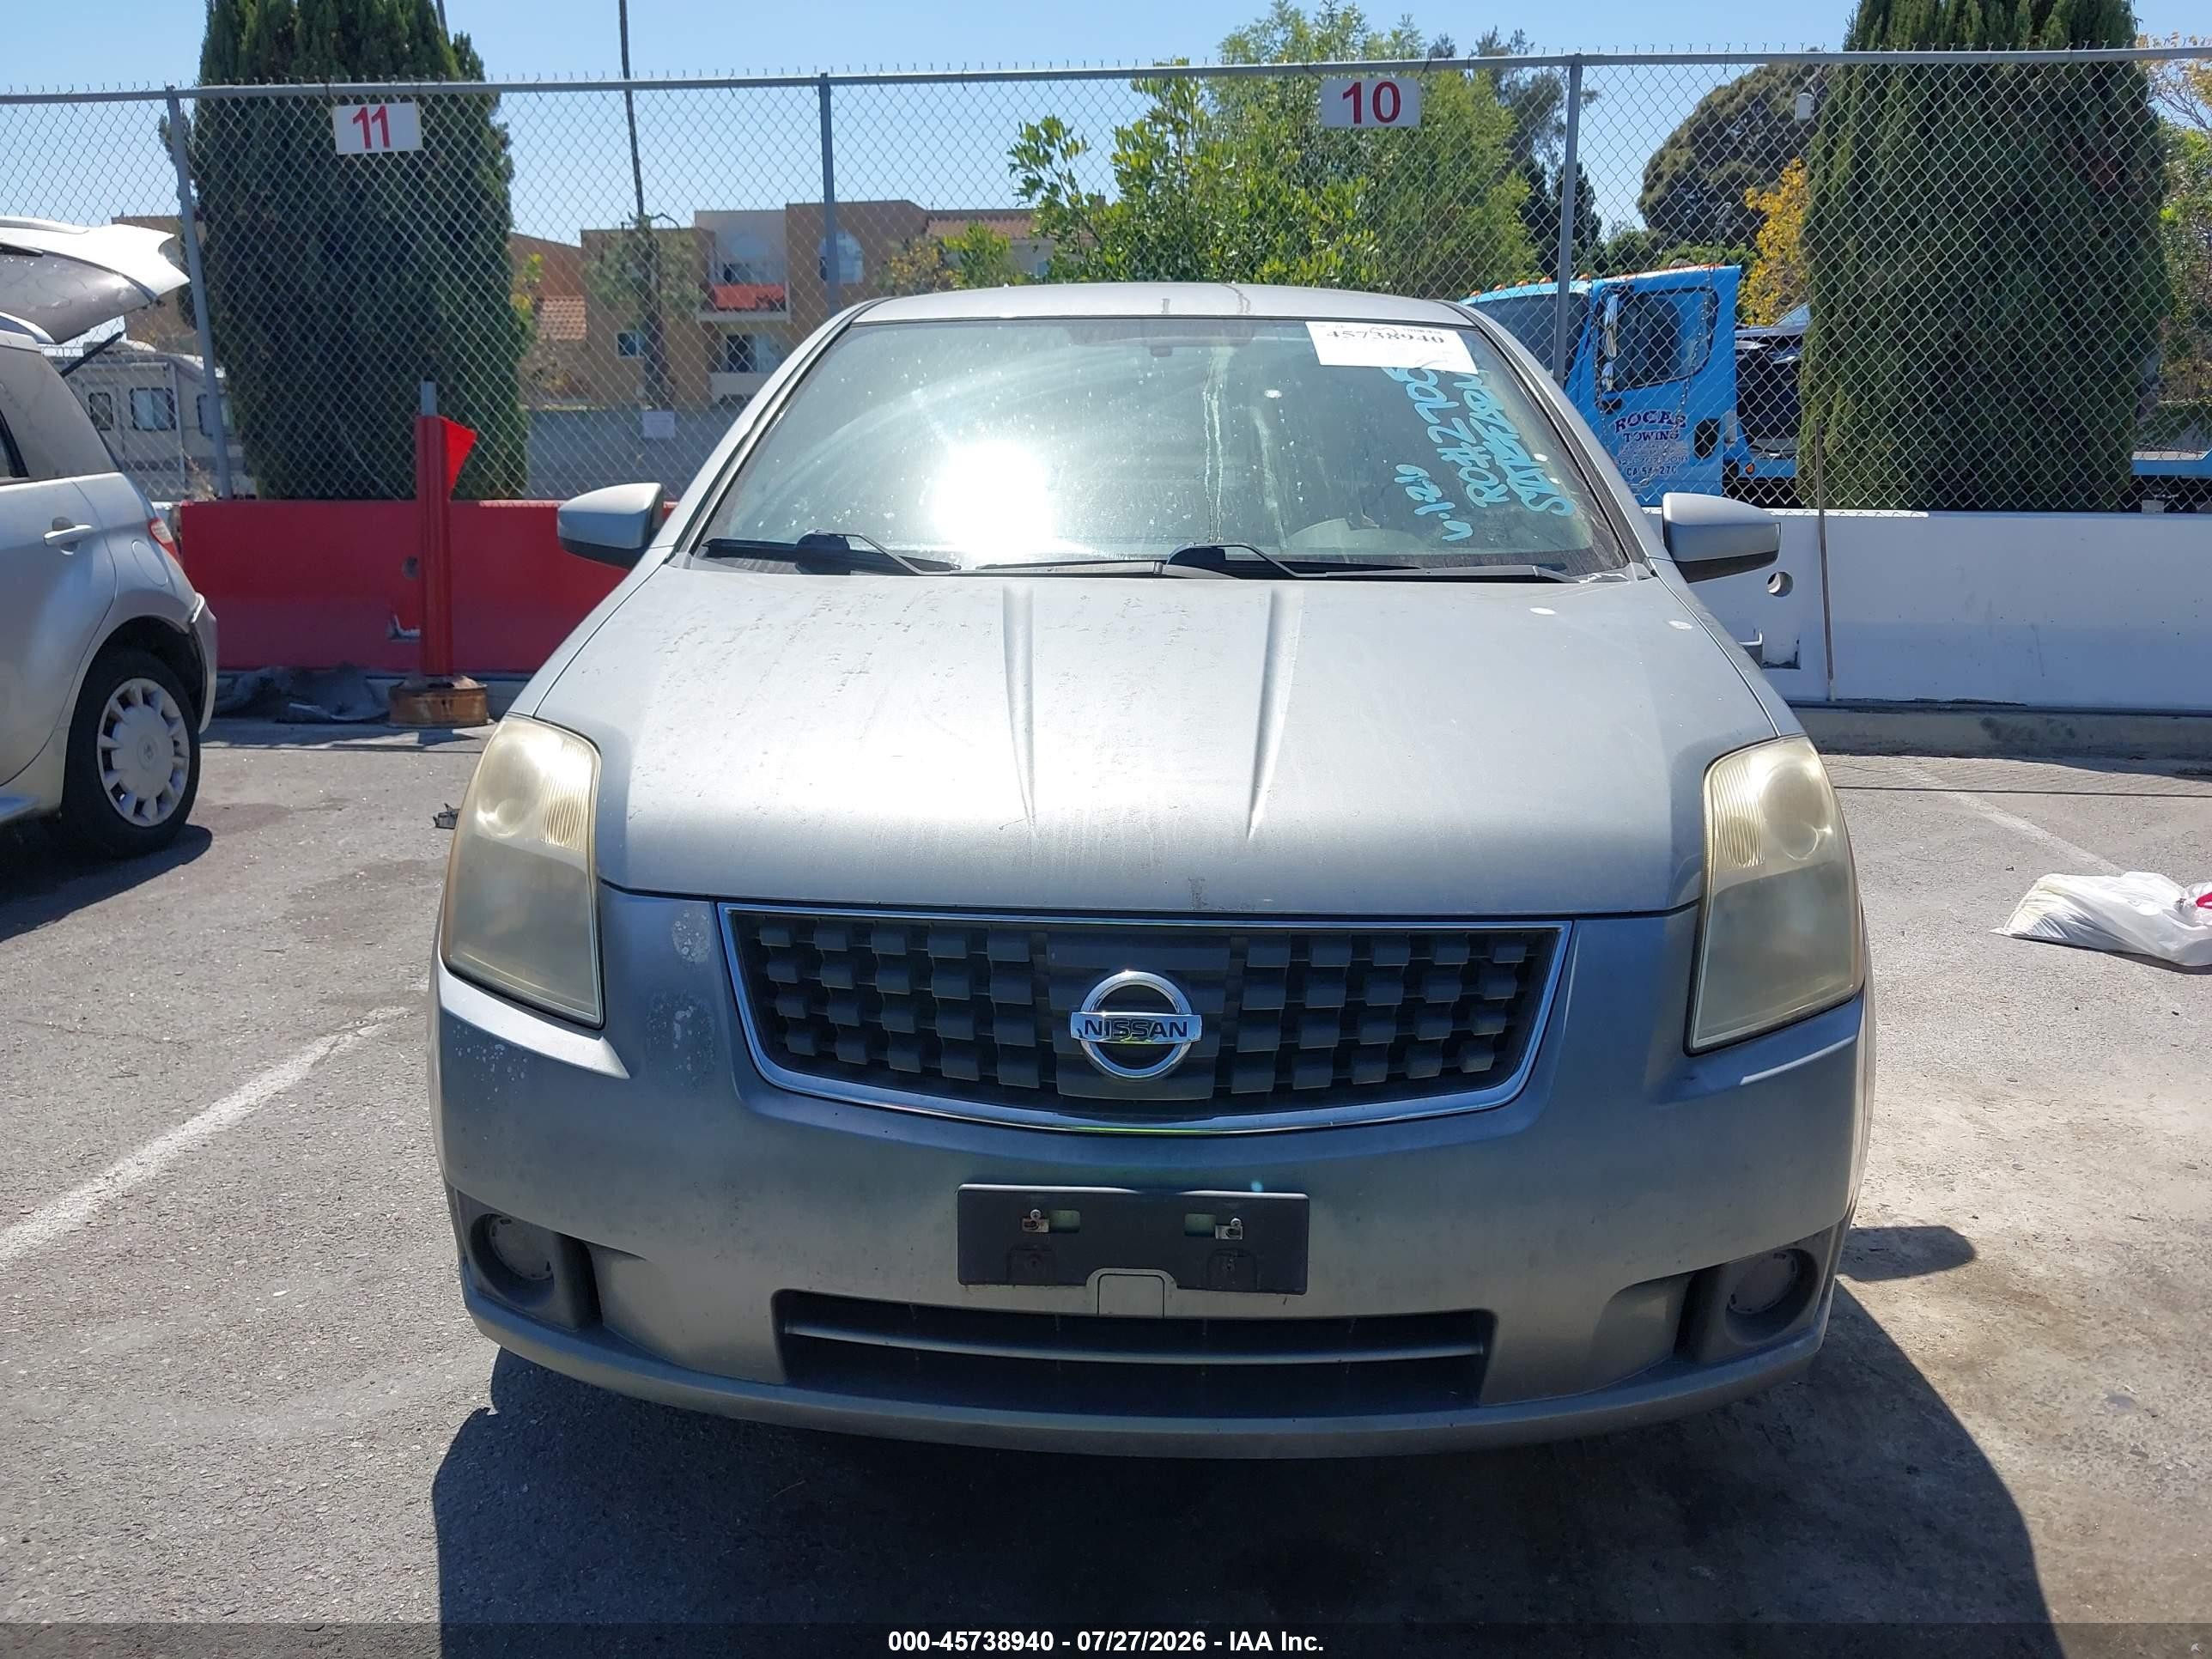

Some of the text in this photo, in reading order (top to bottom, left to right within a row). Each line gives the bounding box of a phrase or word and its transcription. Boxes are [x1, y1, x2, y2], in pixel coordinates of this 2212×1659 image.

[1342, 81, 1401, 125] 10
[352, 105, 391, 149] 11
[1623, 430, 1679, 442] TOWING
[1085, 1018, 1188, 1038] NISSAN
